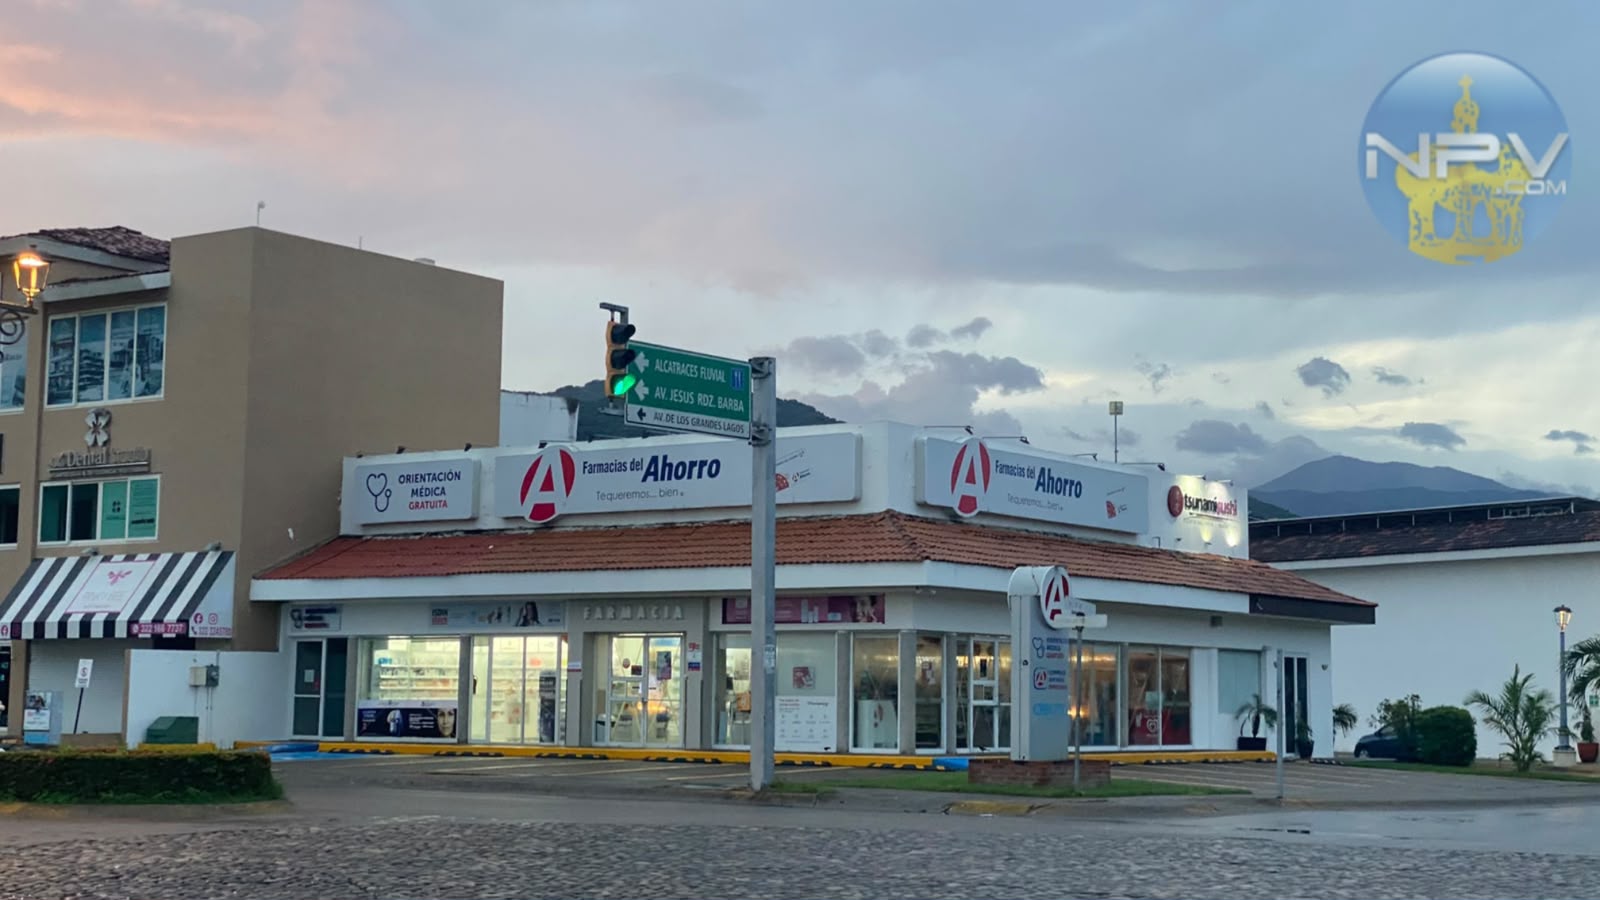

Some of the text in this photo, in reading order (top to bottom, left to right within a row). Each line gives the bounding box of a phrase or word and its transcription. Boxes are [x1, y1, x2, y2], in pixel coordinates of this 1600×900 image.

[654, 358, 726, 383] ALCATRACES FLUVIAL
[654, 387, 744, 413] AV. JESUS RDZ. BARBA
[666, 413, 676, 423] DE
[676, 415, 689, 426] LOS
[691, 417, 722, 431] GRANDES
[723, 422, 745, 434] LAGOS
[398, 469, 461, 484] ORIENTACIÓN
[582, 454, 721, 483] Farmacias del Ahorro
[995, 460, 1083, 499] Farmacias del Ahorro
[410, 485, 446, 498] MÉDICA
[408, 500, 448, 510] GRATUITA
[583, 605, 685, 621] FARMACIA
